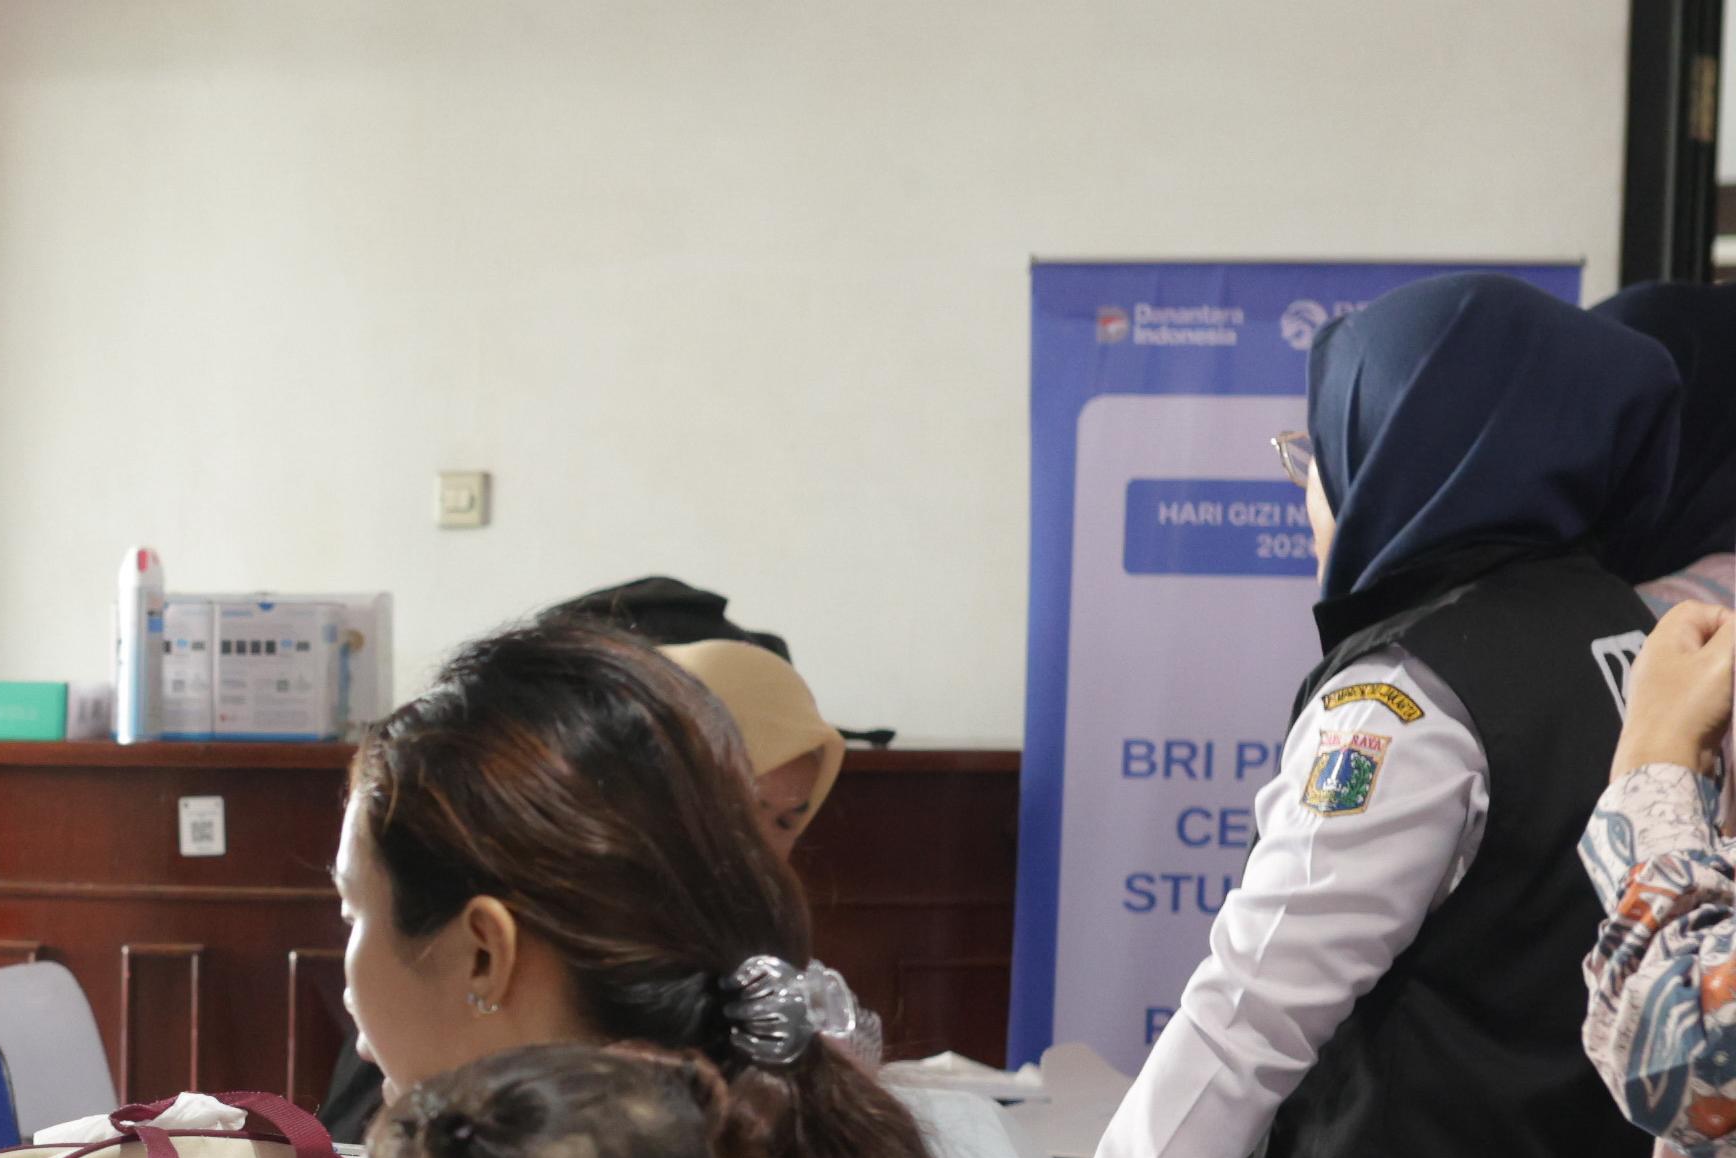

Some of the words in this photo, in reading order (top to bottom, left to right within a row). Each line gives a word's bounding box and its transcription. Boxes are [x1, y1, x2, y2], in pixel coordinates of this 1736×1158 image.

[1133, 329, 1238, 346] Indonesia
[1159, 502, 1222, 525] HARI
[1228, 502, 1280, 527] GIZI
[1122, 739, 1213, 781] BRI
[1176, 806, 1251, 849] CE
[1122, 872, 1233, 916] STU
